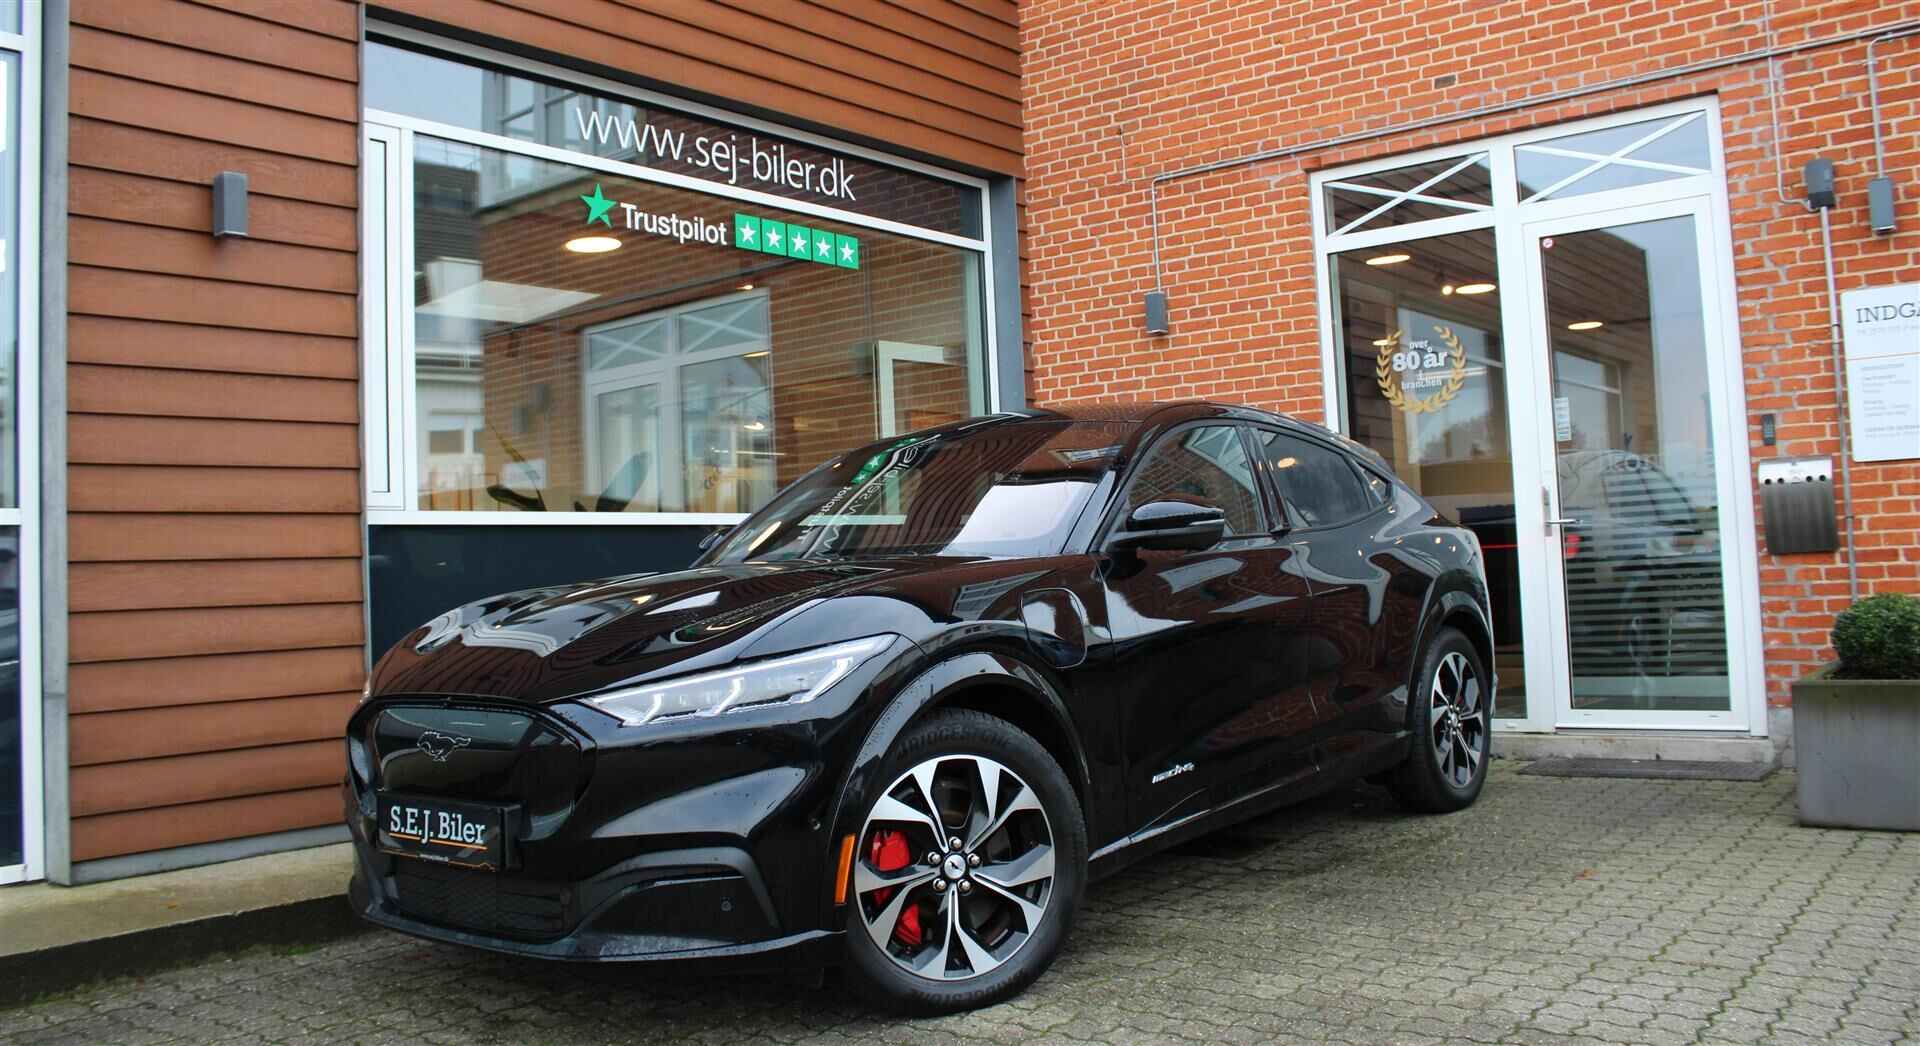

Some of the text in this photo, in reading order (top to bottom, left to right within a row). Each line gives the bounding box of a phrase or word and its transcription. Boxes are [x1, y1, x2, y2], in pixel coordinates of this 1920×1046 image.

[576, 107, 857, 201] www.sej-biler.dk
[620, 202, 728, 246] Trustpilot
[1392, 346, 1448, 372] 80 år
[1409, 340, 1428, 350] over
[1401, 377, 1442, 390] branchen
[390, 805, 485, 844] S.E.J. Biler
